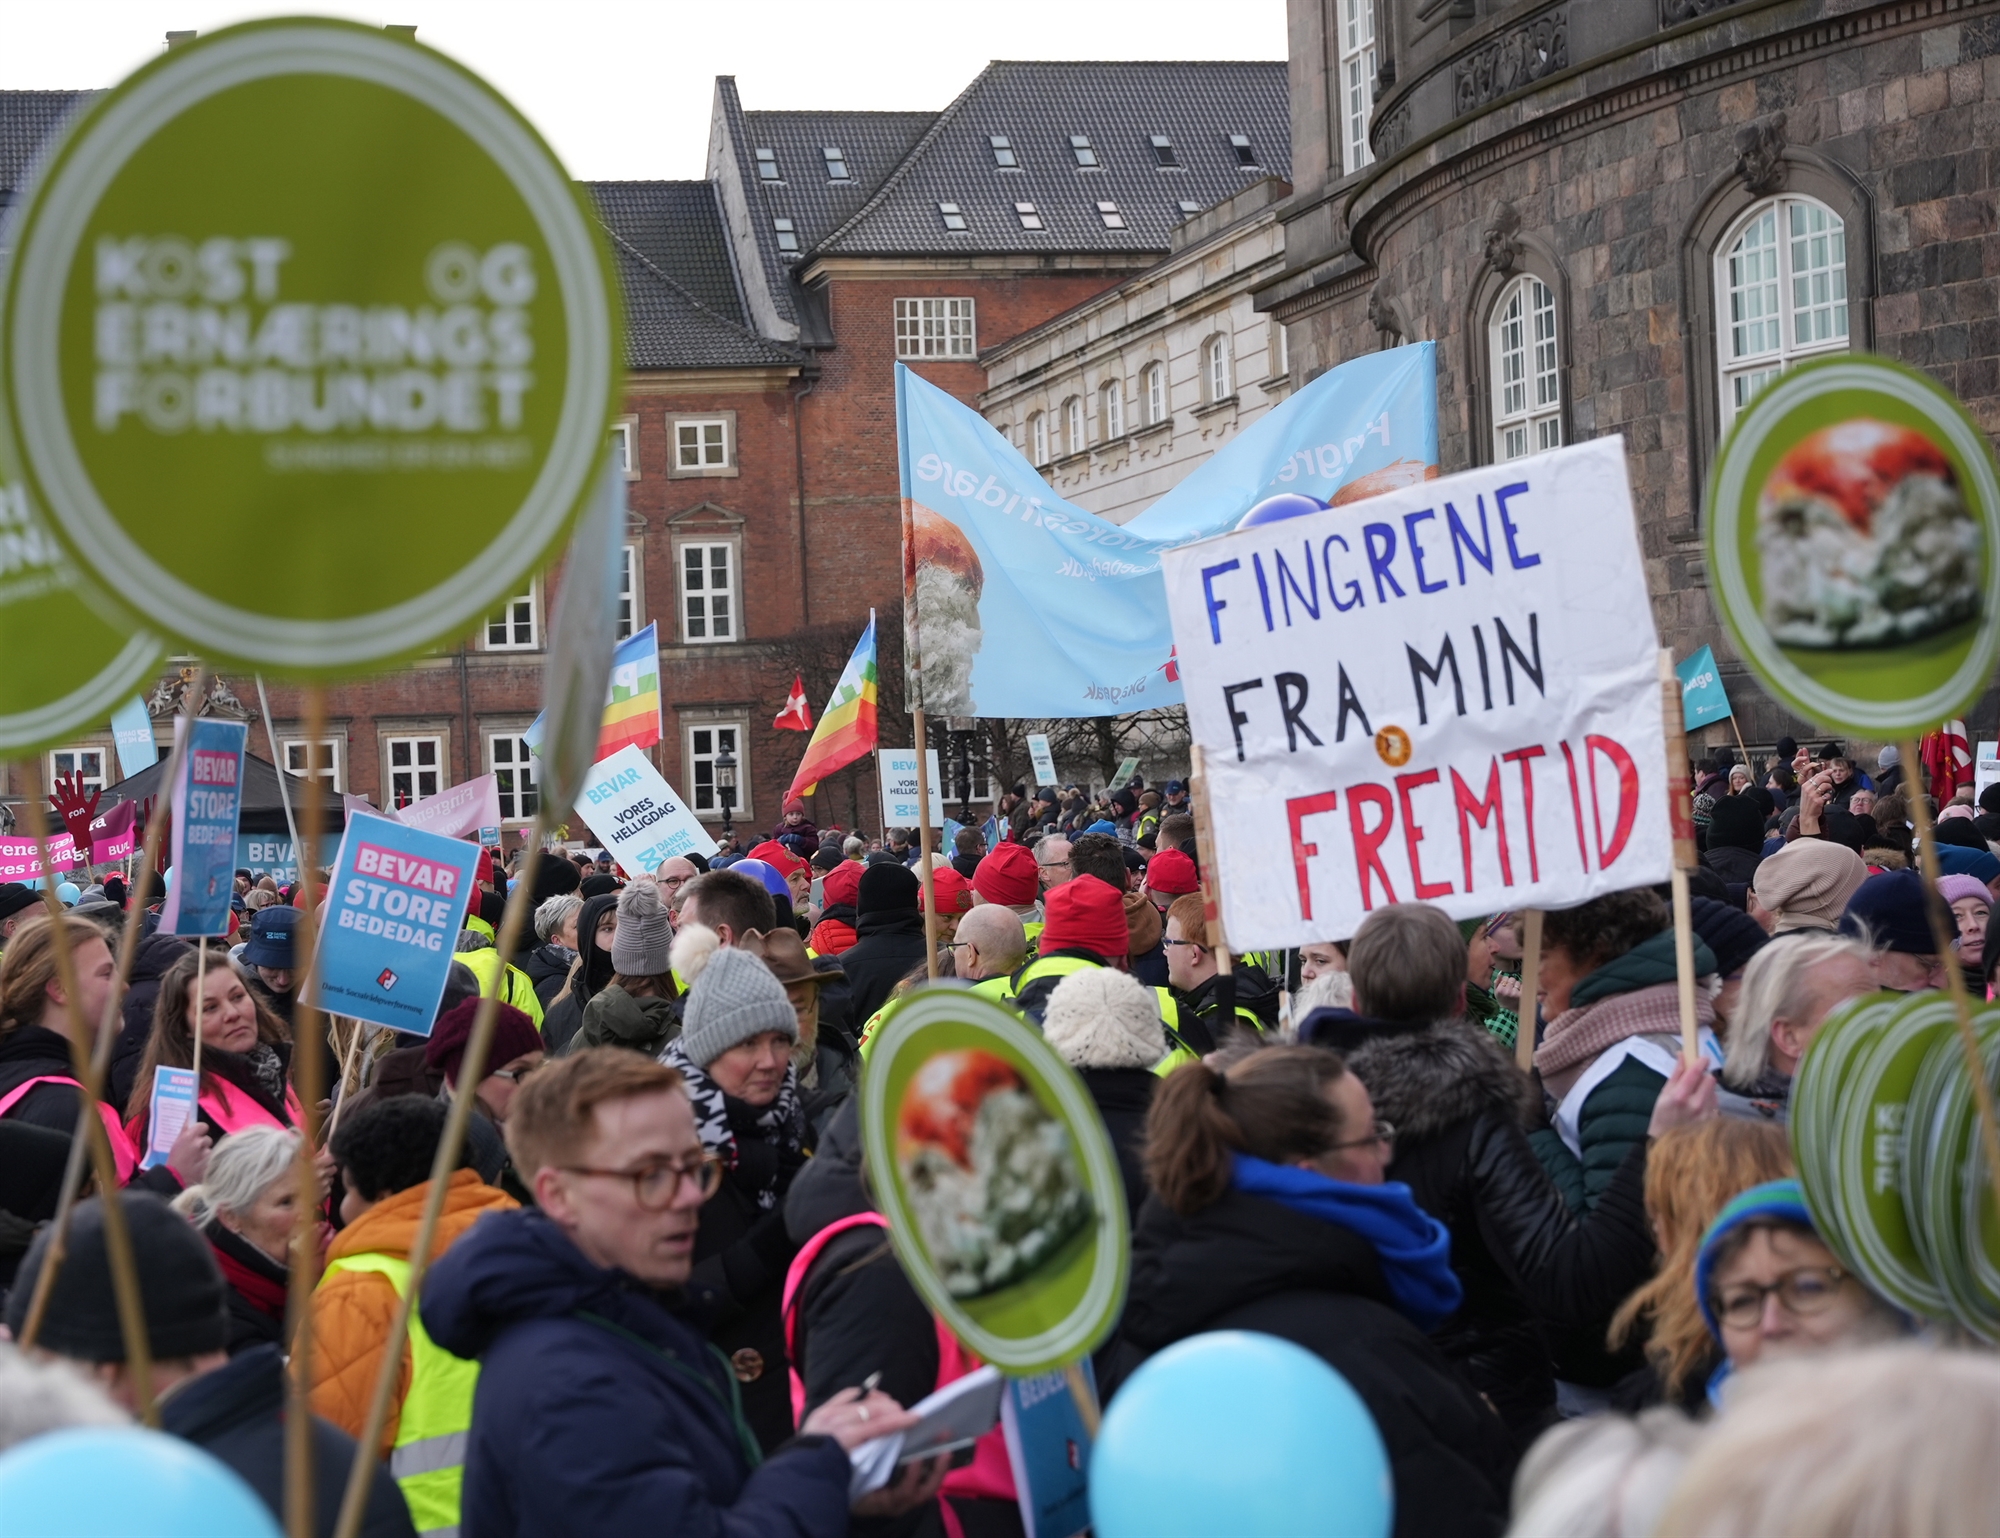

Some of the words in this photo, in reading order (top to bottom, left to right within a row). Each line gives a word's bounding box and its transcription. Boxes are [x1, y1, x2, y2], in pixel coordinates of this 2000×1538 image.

[95, 236, 289, 301] KOST
[424, 241, 537, 304] OG
[95, 303, 533, 368] ERNÆRINGS
[95, 368, 534, 434] FORBUNDET
[1201, 481, 1541, 645] FINGRENE
[1222, 660, 1375, 762] FRA
[1404, 612, 1545, 726] MIN
[193, 757, 236, 782] BEVAR
[585, 767, 642, 805] BEVAR
[892, 761, 918, 770] BEVA
[68, 807, 86, 819] FOA
[190, 791, 234, 819] STORE
[611, 802, 676, 844] HELLIGDAG
[614, 797, 654, 824] VORES
[656, 828, 690, 852] DANSK
[1286, 734, 1639, 920] FREMTID
[662, 839, 696, 859] METAL
[357, 848, 454, 895] BEVAR
[344, 878, 452, 929] STORE
[338, 908, 443, 951] BEDEDAG
[321, 982, 344, 994] Dansk
